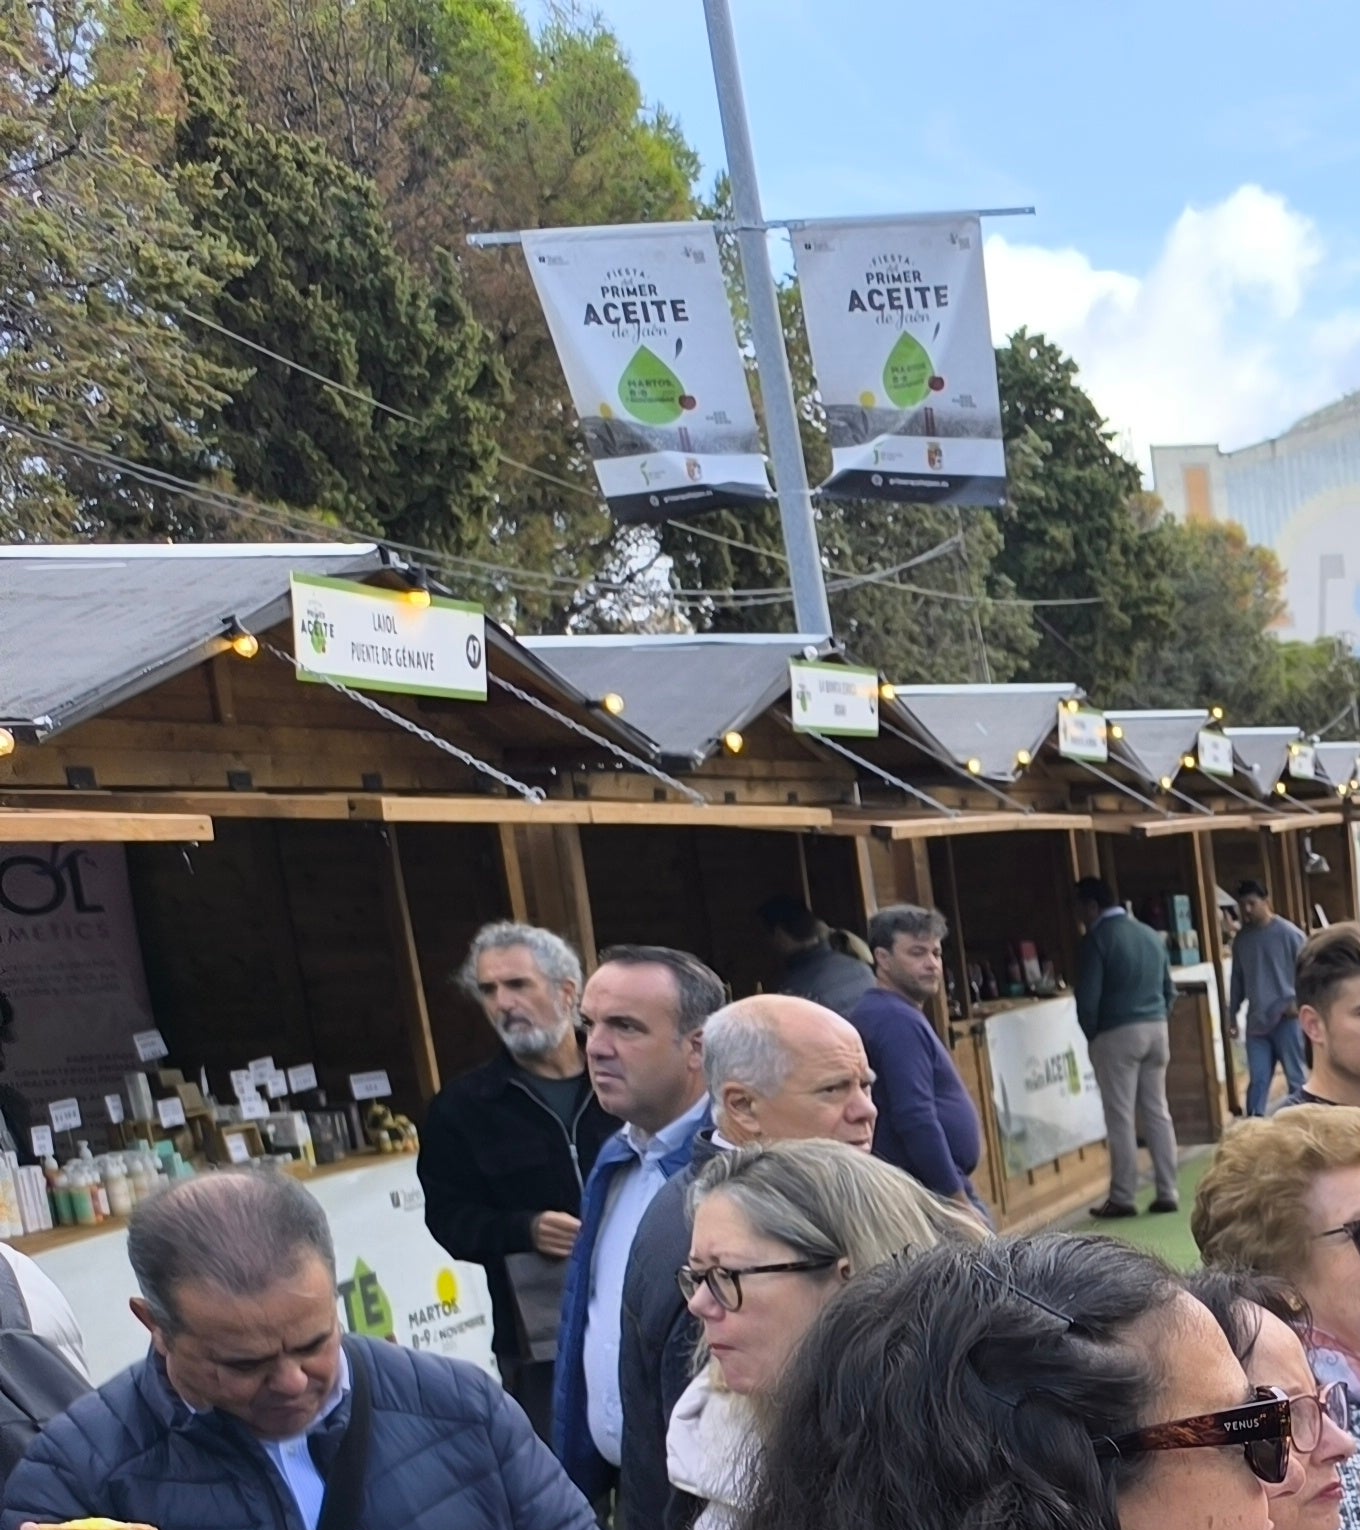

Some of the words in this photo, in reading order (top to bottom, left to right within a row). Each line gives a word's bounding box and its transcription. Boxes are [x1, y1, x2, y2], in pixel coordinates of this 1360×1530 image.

[606, 268, 646, 280] FIESTA
[866, 270, 921, 285] PRIMER
[601, 284, 658, 298] PRIMER
[849, 285, 949, 312] ACEITE
[584, 300, 689, 325] ACEITE
[301, 618, 334, 639] ACEITE
[372, 612, 398, 635] LAIOL
[351, 642, 380, 666] PUENTE
[382, 647, 393, 667] DE
[395, 645, 436, 672] GÉNAVE
[408, 1297, 460, 1330] MARTOS
